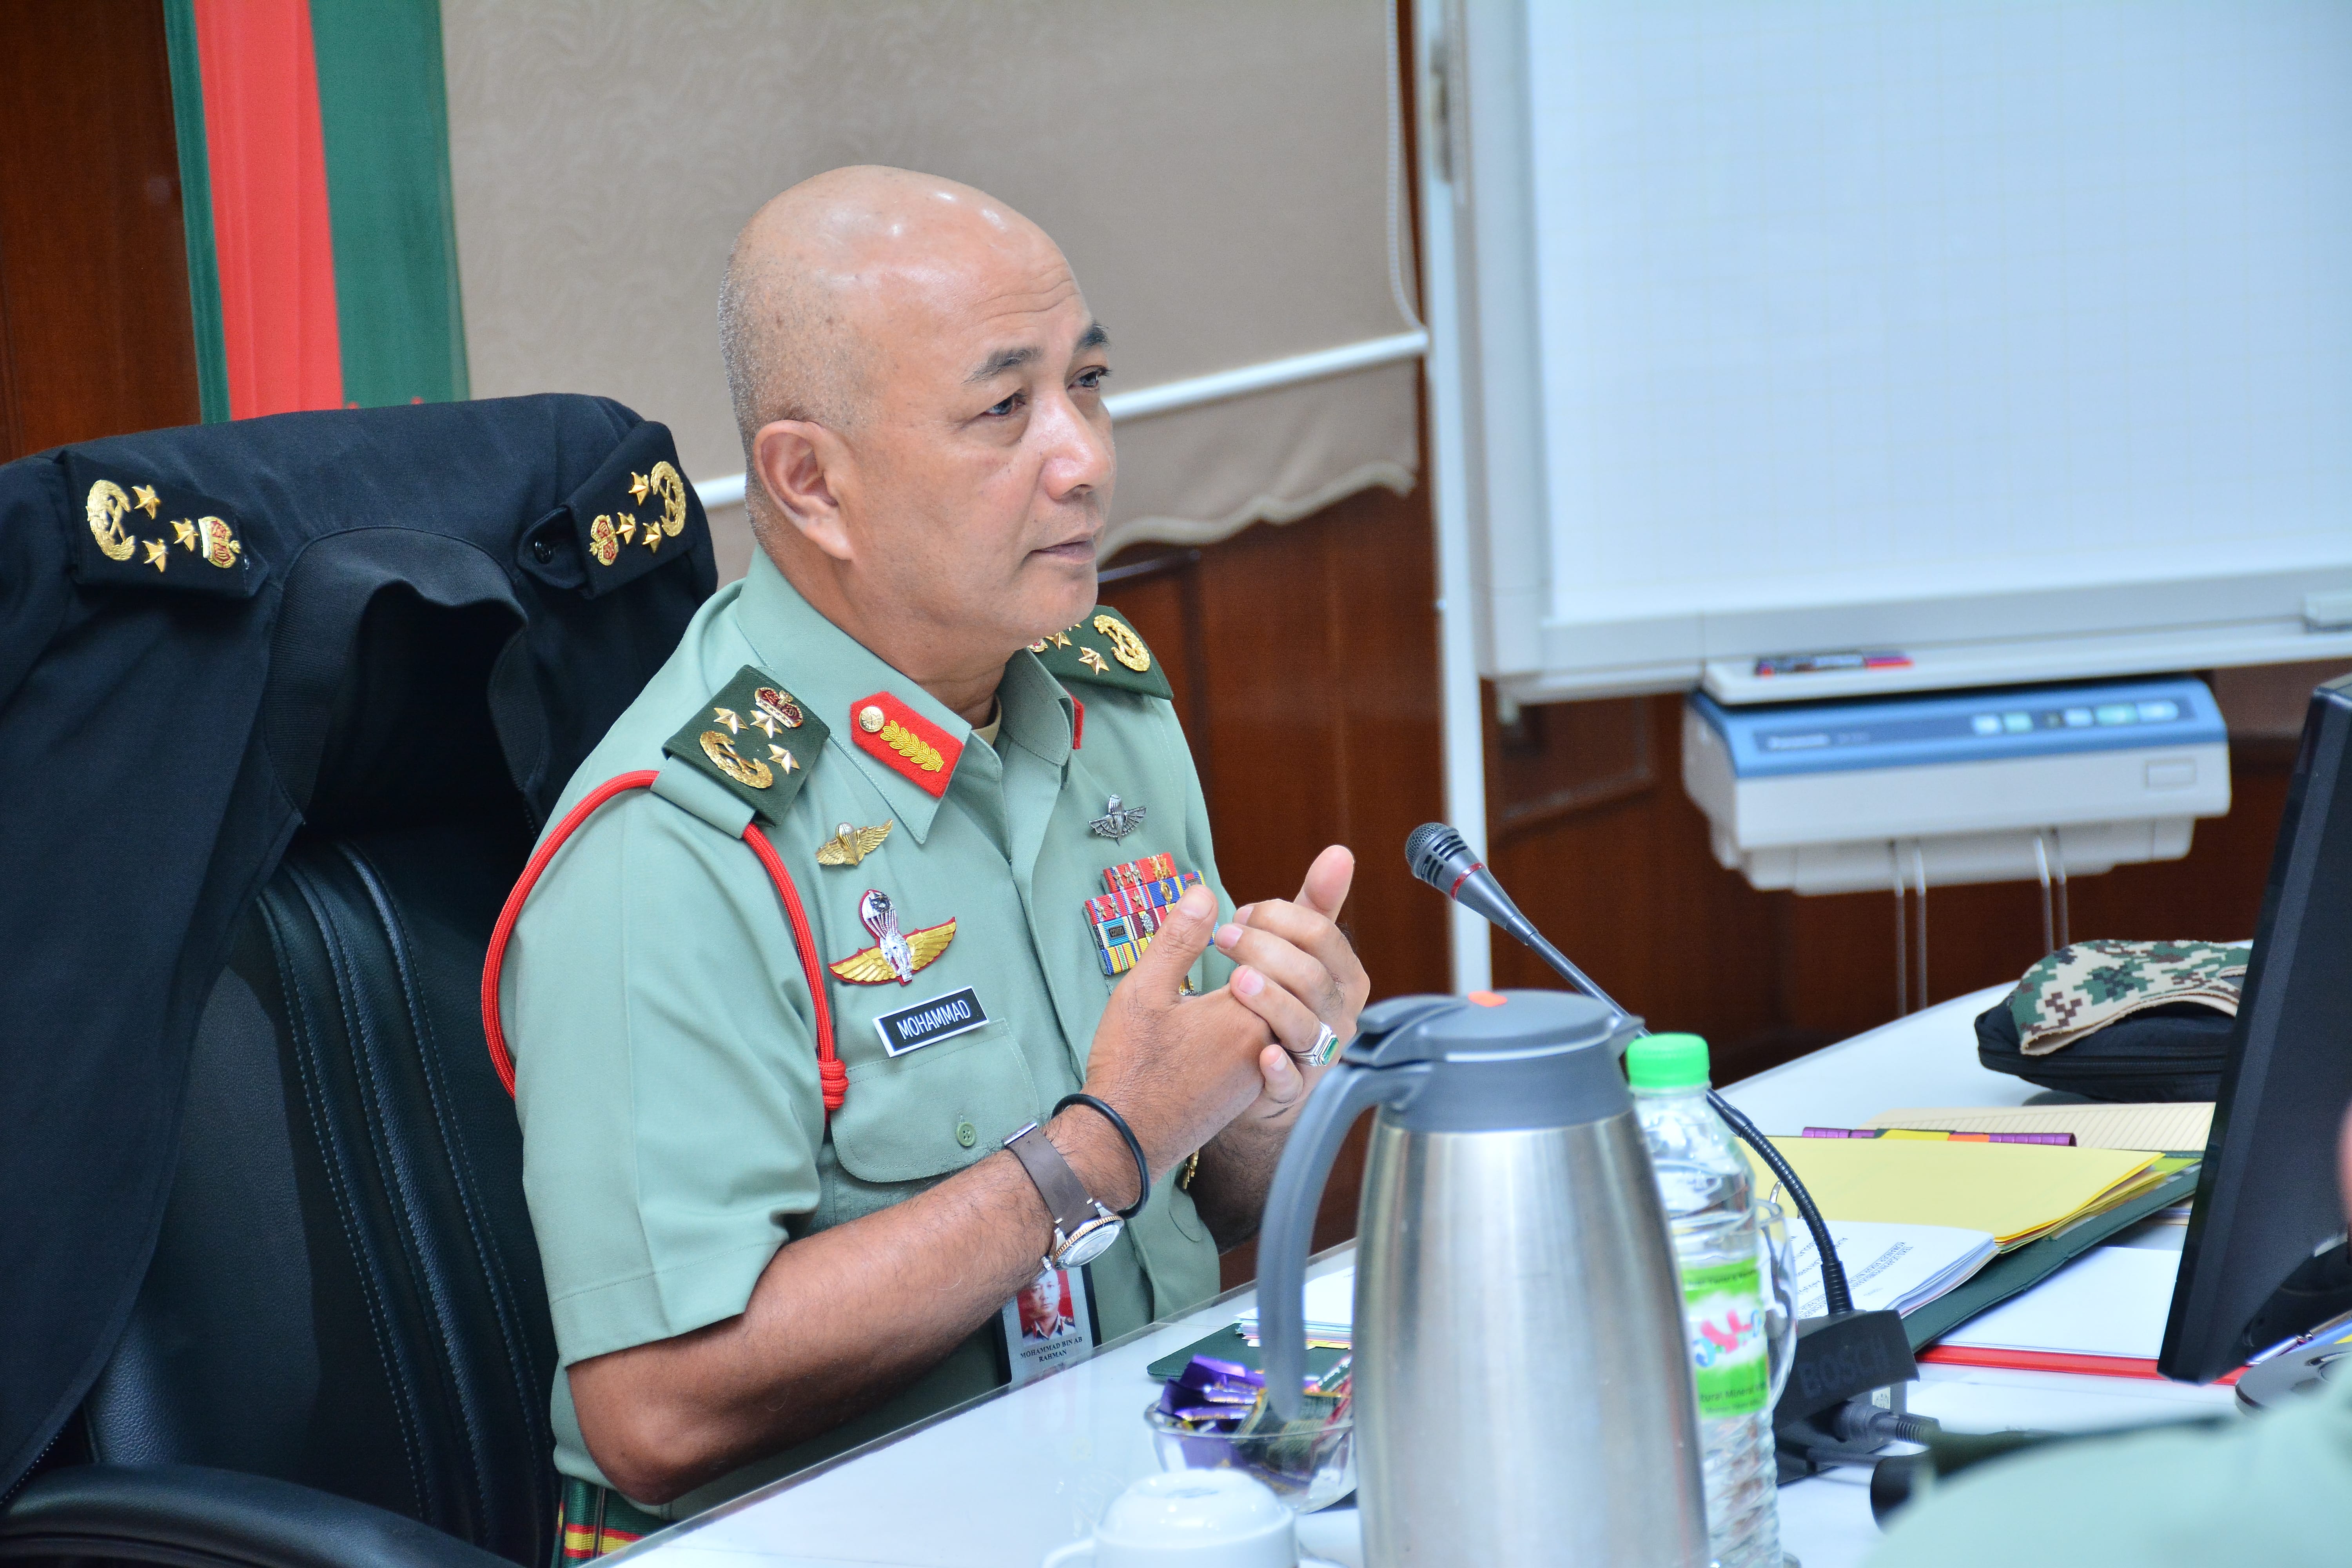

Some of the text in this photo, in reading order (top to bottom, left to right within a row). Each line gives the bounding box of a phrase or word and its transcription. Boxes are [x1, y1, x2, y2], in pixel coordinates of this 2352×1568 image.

[1110, 927, 1124, 936] CONGO
[896, 1000, 971, 1040] MOHAMMAD
[1020, 1343, 1060, 1359] MOHAMMAD
[1039, 1349, 1067, 1363] RAHMAN
